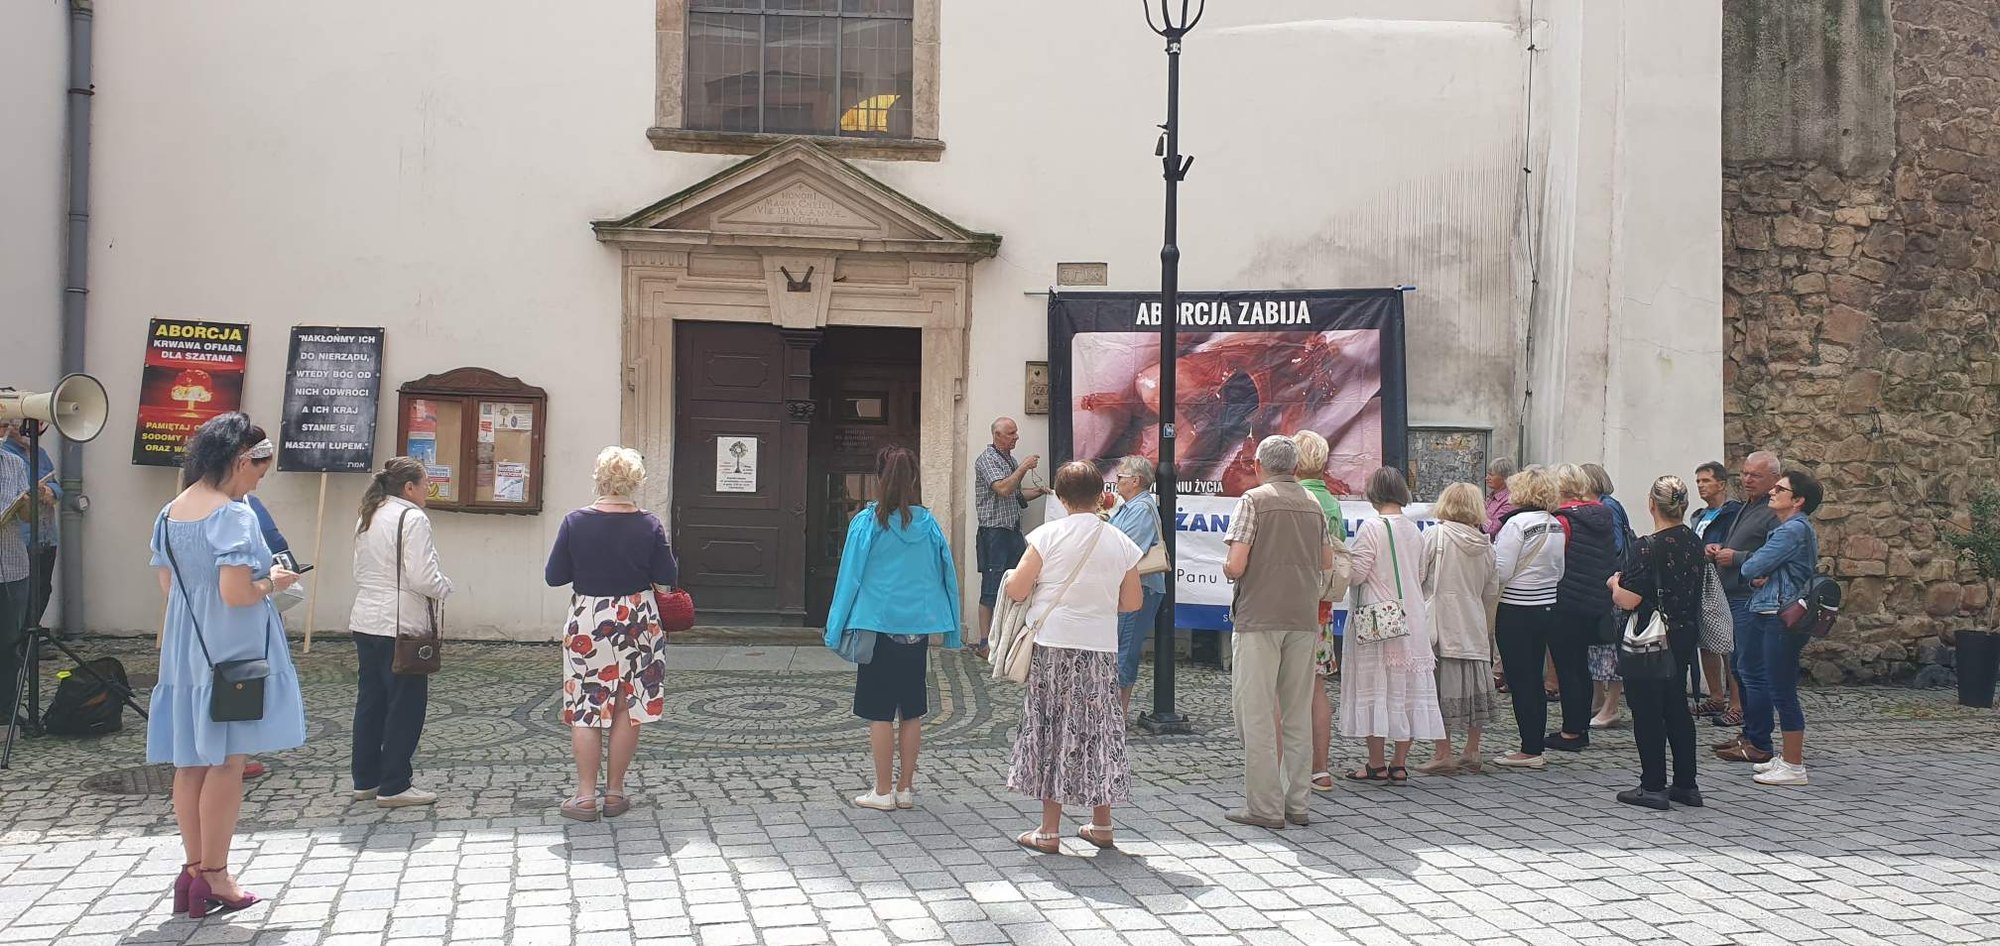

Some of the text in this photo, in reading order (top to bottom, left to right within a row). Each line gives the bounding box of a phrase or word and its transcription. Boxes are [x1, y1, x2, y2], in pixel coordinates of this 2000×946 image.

[1136, 300, 1311, 325] ABRCJA ZABIJA
[156, 324, 242, 340] ABORCJA
[153, 340, 242, 352] KRWAWA OFIARA
[161, 351, 234, 362] DLA SZATANA
[300, 352, 315, 360] DO
[296, 370, 329, 378] WTEDY
[357, 371, 372, 379] OD
[333, 406, 359, 414] KRAJ
[146, 421, 190, 431] PAMIĘTAJ
[301, 423, 337, 431] STANIE
[142, 433, 182, 441] SODOMY
[145, 444, 171, 452] ORAZ
[285, 441, 325, 449] NASZYM
[1194, 478, 1224, 493] ŻYCIA
[1177, 568, 1217, 584] Panu
